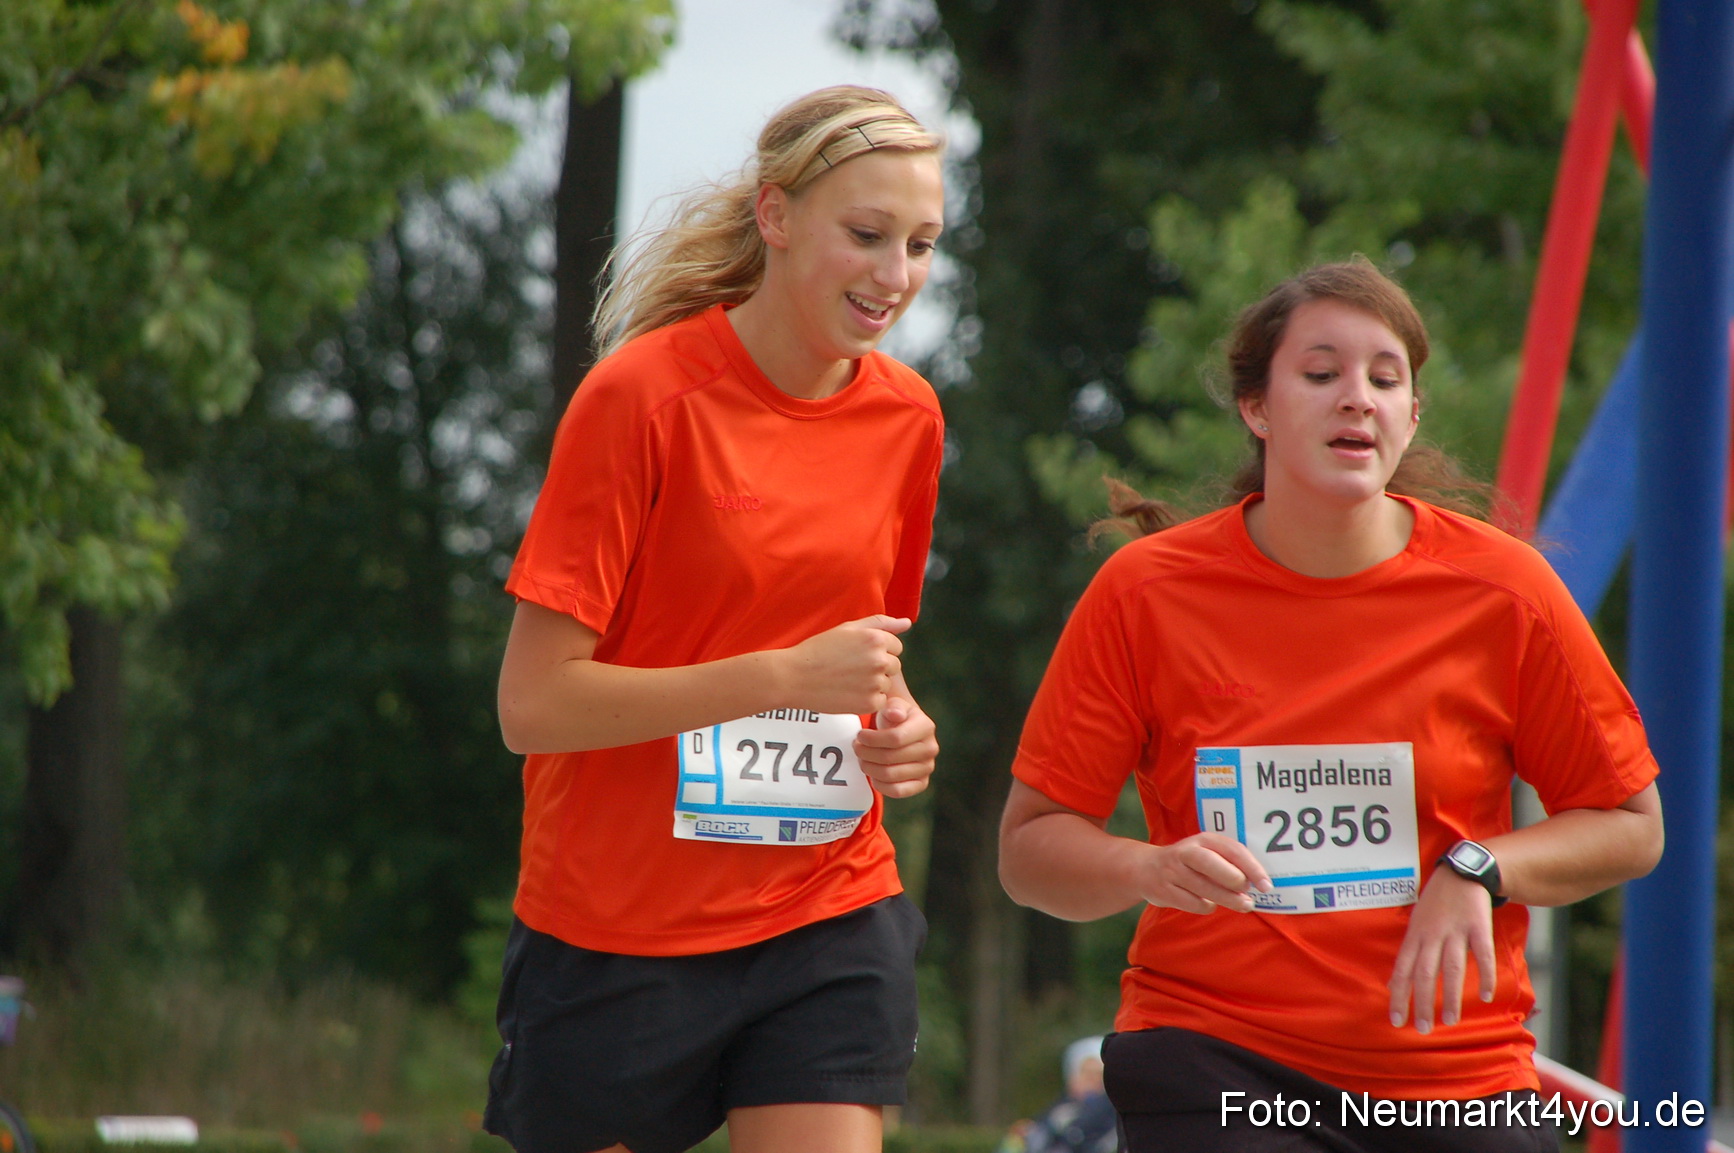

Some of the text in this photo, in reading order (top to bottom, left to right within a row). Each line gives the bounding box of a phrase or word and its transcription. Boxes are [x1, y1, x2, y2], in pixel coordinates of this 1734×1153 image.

[693, 732, 704, 754] D
[736, 739, 848, 787] 2742
[1256, 759, 1393, 793] Magdalena
[695, 820, 750, 834] BOCK
[1214, 811, 1225, 832] D
[1263, 804, 1392, 853] 2856
[1337, 879, 1417, 899] PFLEIDERER
